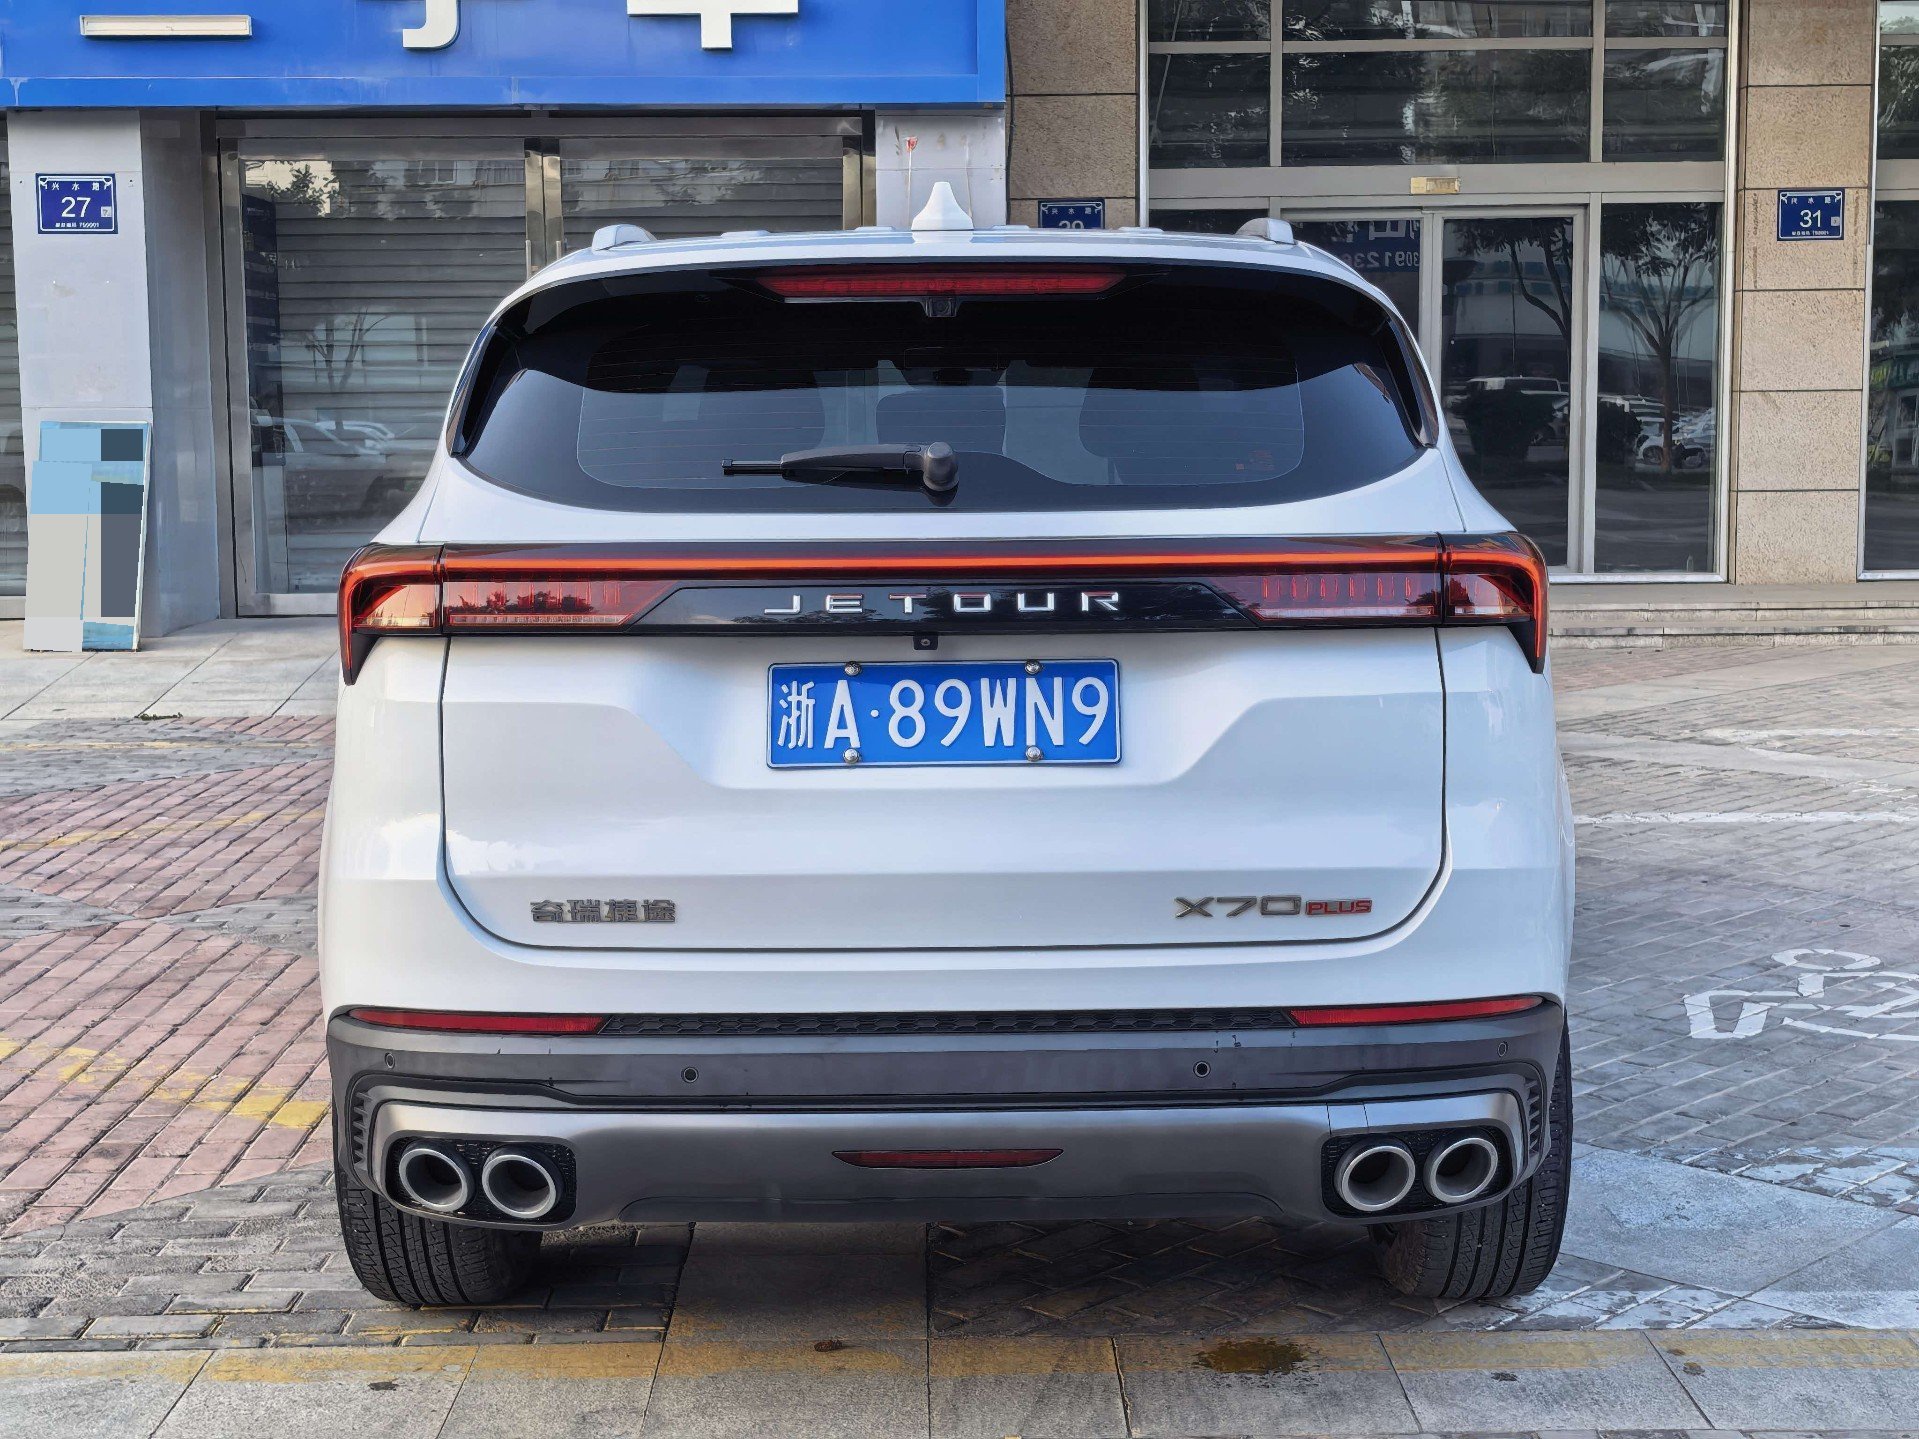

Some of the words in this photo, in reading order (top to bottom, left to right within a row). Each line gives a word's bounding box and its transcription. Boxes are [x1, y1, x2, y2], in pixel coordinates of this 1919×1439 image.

[61, 196, 91, 218] 27
[1799, 209, 1821, 228] 31
[764, 591, 1119, 615] JETOUR
[1174, 895, 1302, 919] X70
[1304, 898, 1373, 916] PLUS
